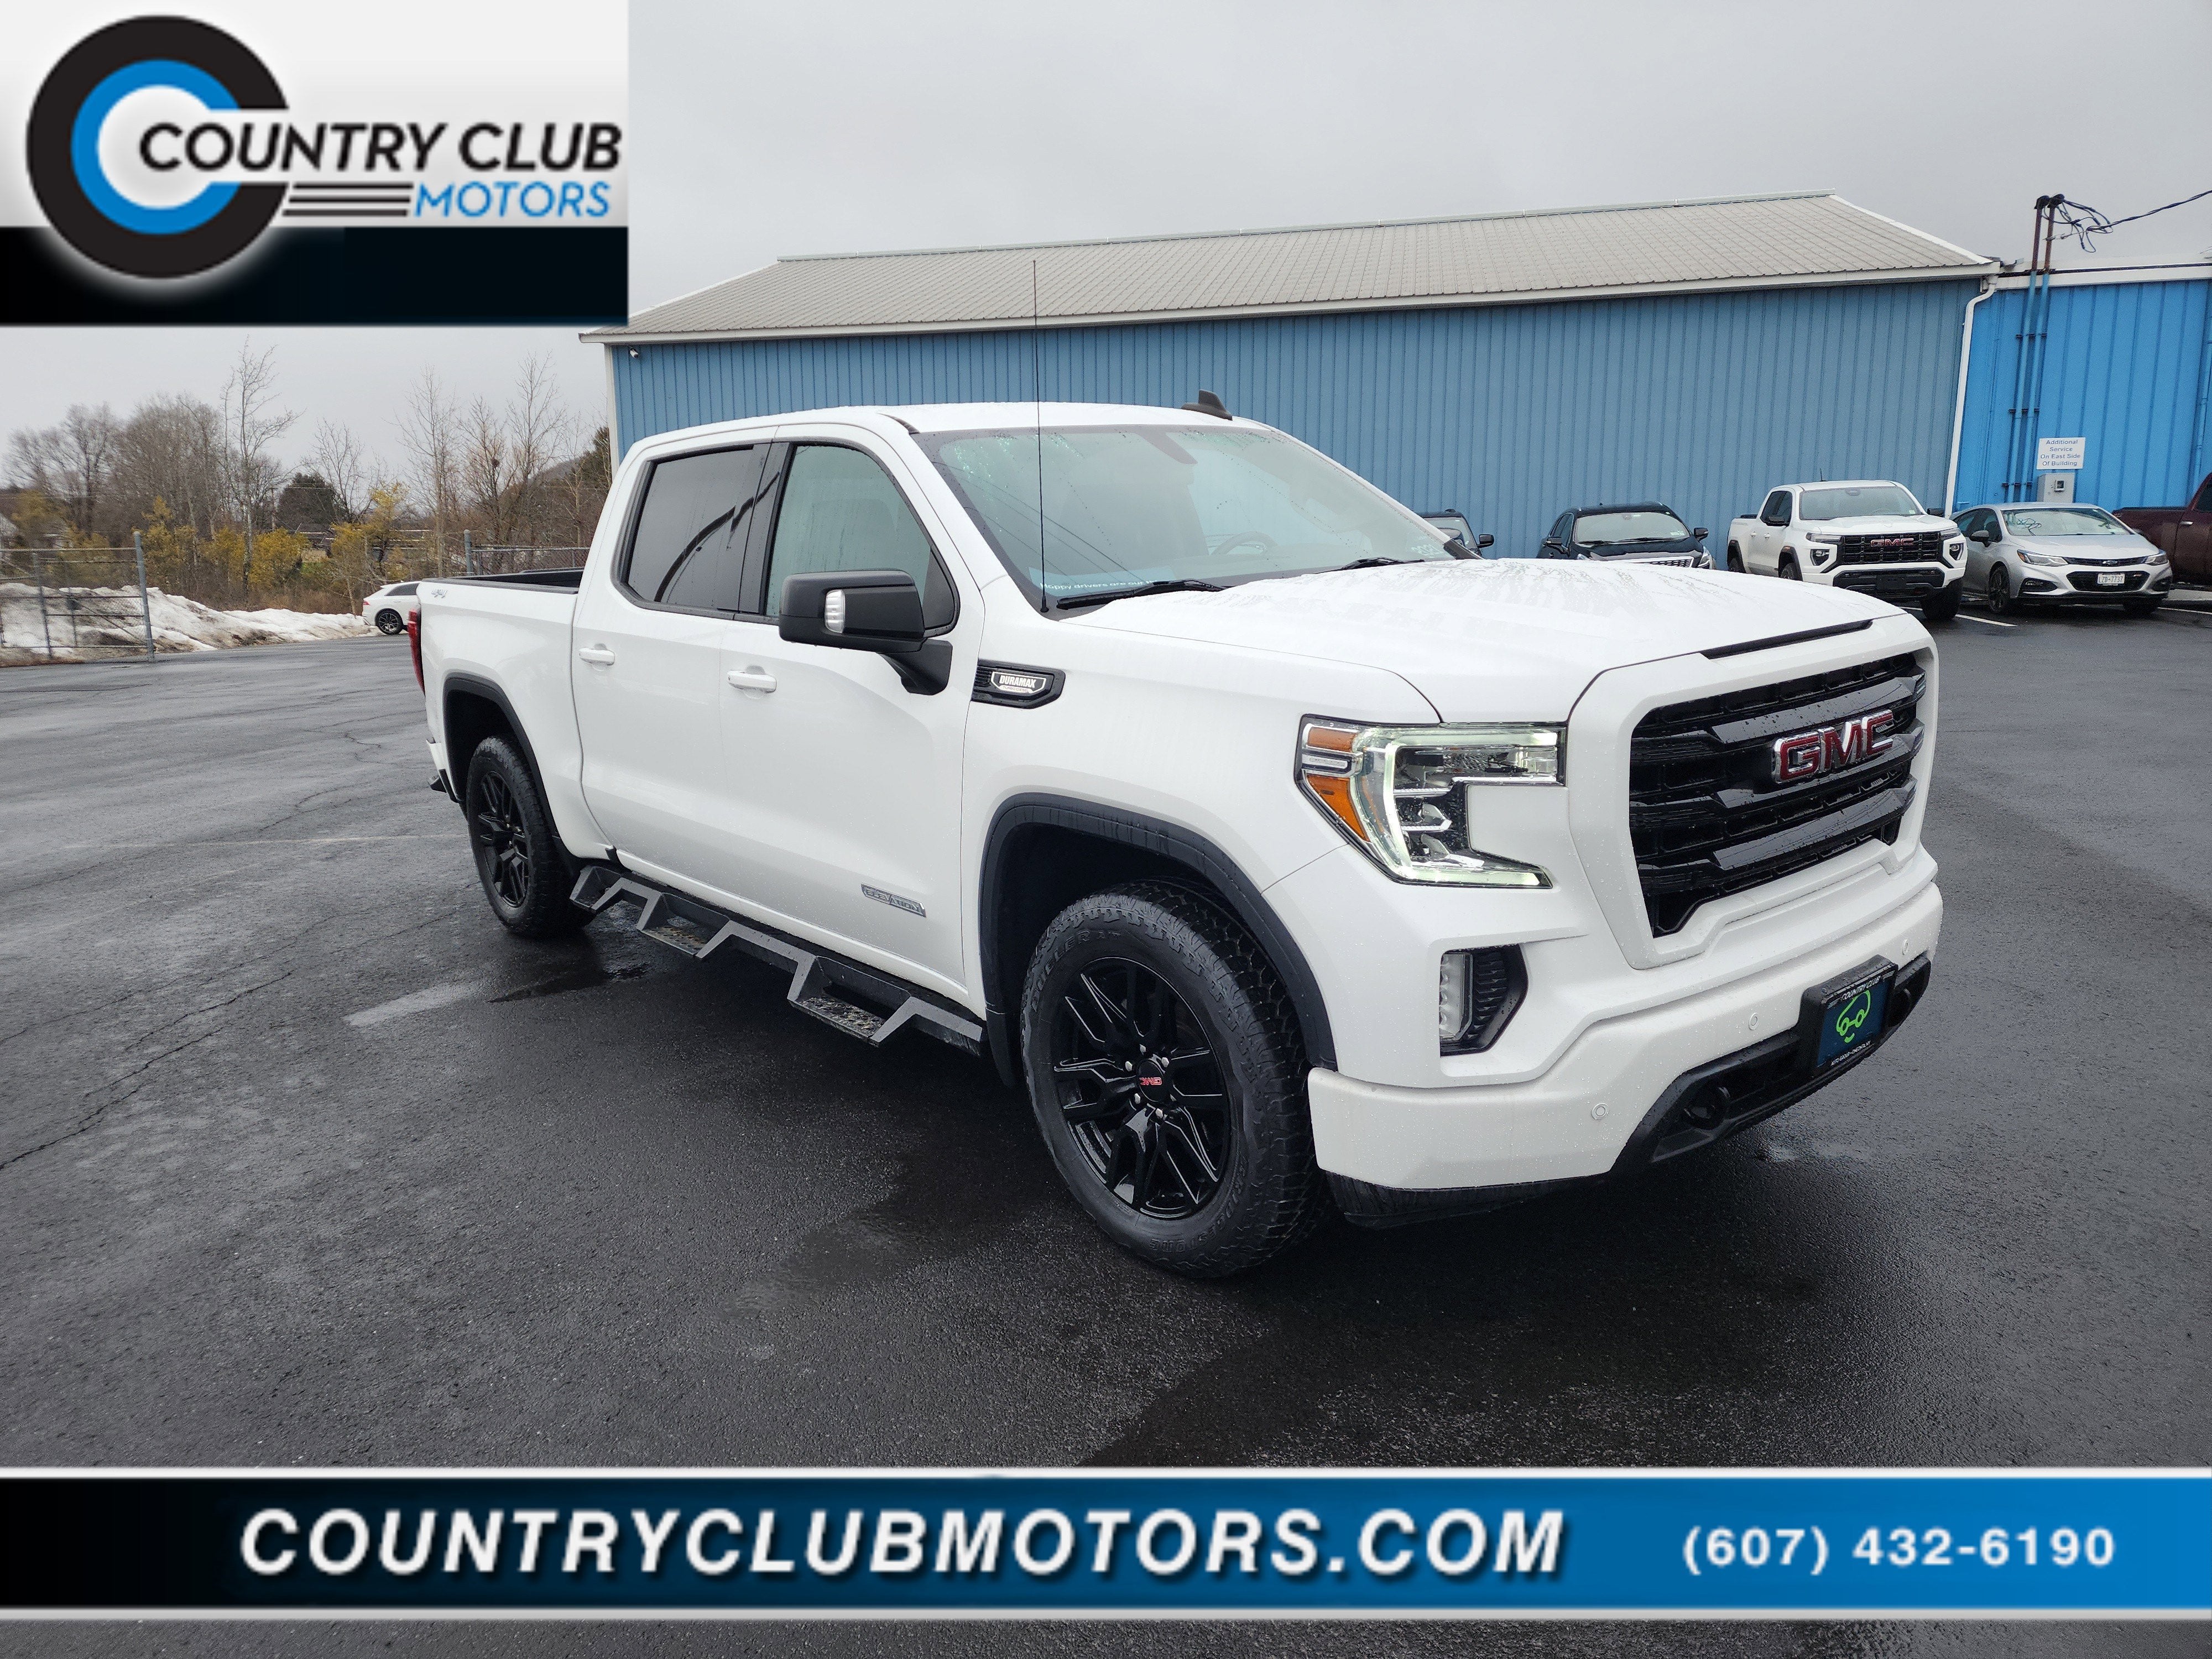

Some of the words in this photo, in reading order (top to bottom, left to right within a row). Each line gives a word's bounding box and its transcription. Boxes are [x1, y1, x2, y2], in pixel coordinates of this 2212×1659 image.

[1870, 538, 1914, 547] GMC
[999, 675, 1037, 688] DURAMAX
[1772, 709, 1894, 784] GMC
